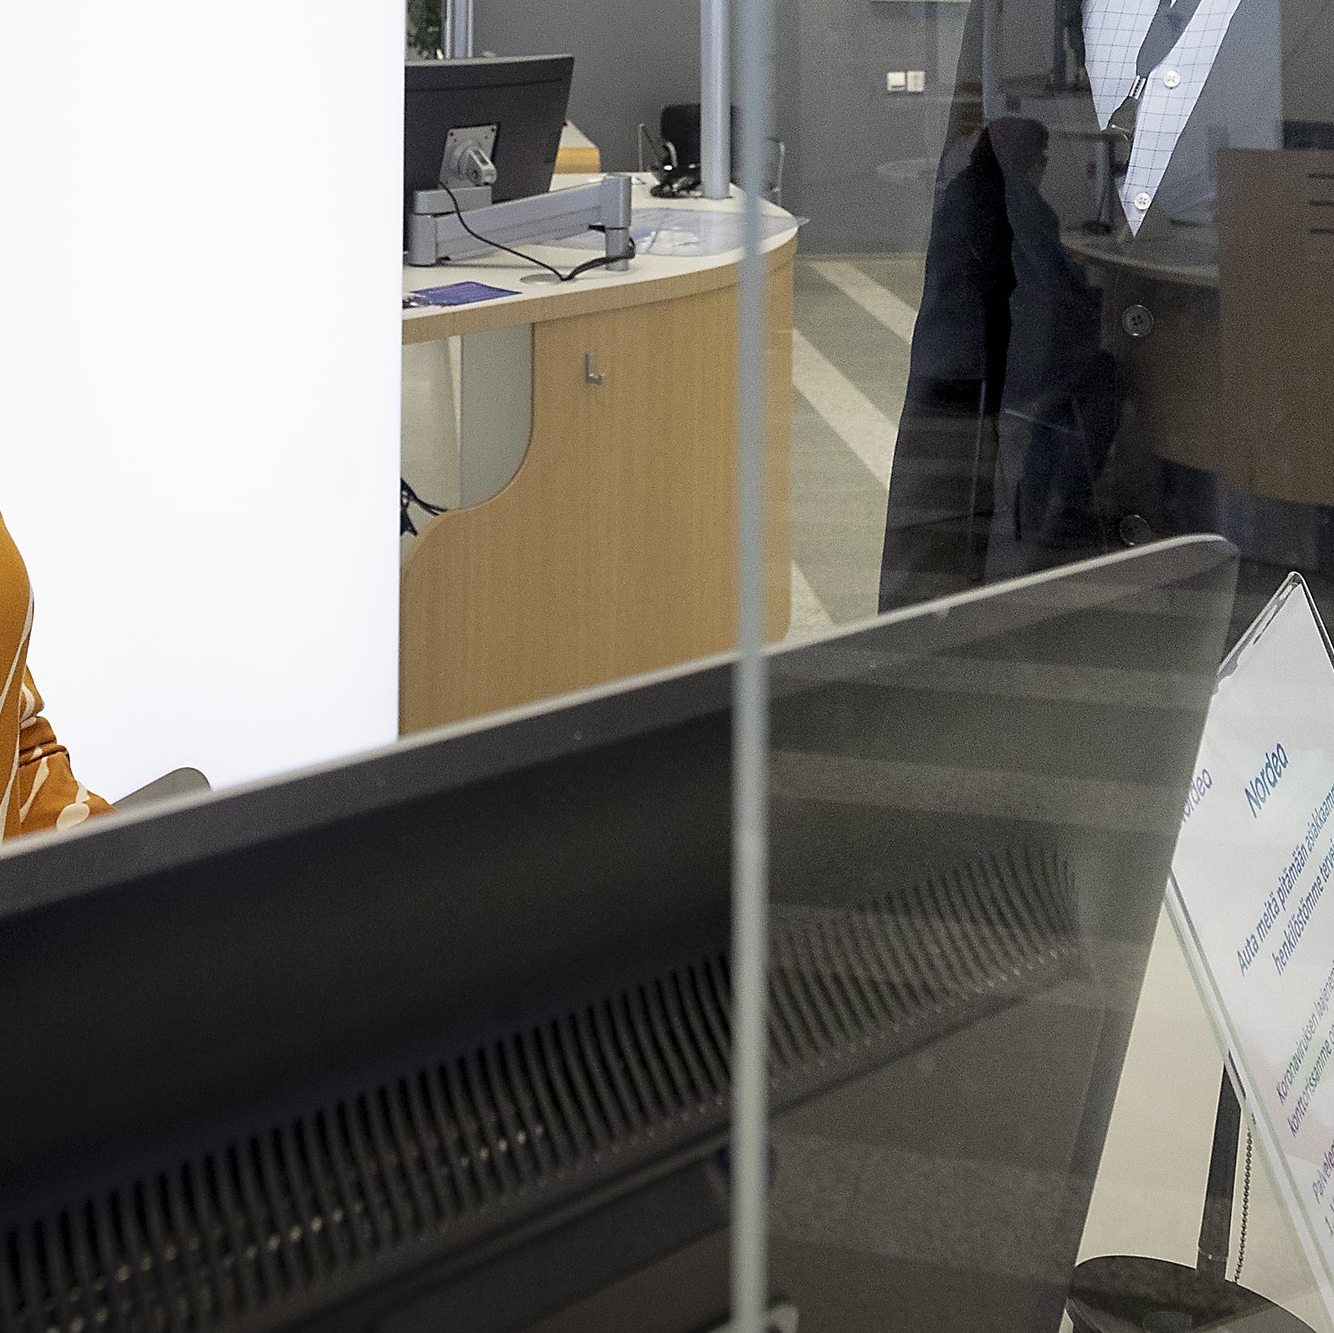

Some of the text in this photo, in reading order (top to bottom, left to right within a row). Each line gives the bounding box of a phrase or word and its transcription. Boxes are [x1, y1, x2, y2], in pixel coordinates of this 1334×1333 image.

[1243, 743, 1289, 818] Nordea
[1236, 933, 1260, 977] Auta
[1256, 892, 1280, 942] meitä
[1277, 844, 1309, 911] pitämään
[1271, 876, 1325, 976] henkilöstömme
[1276, 1013, 1319, 1105] Koronaviruksen
[1287, 1039, 1332, 1138] konttorissamme
